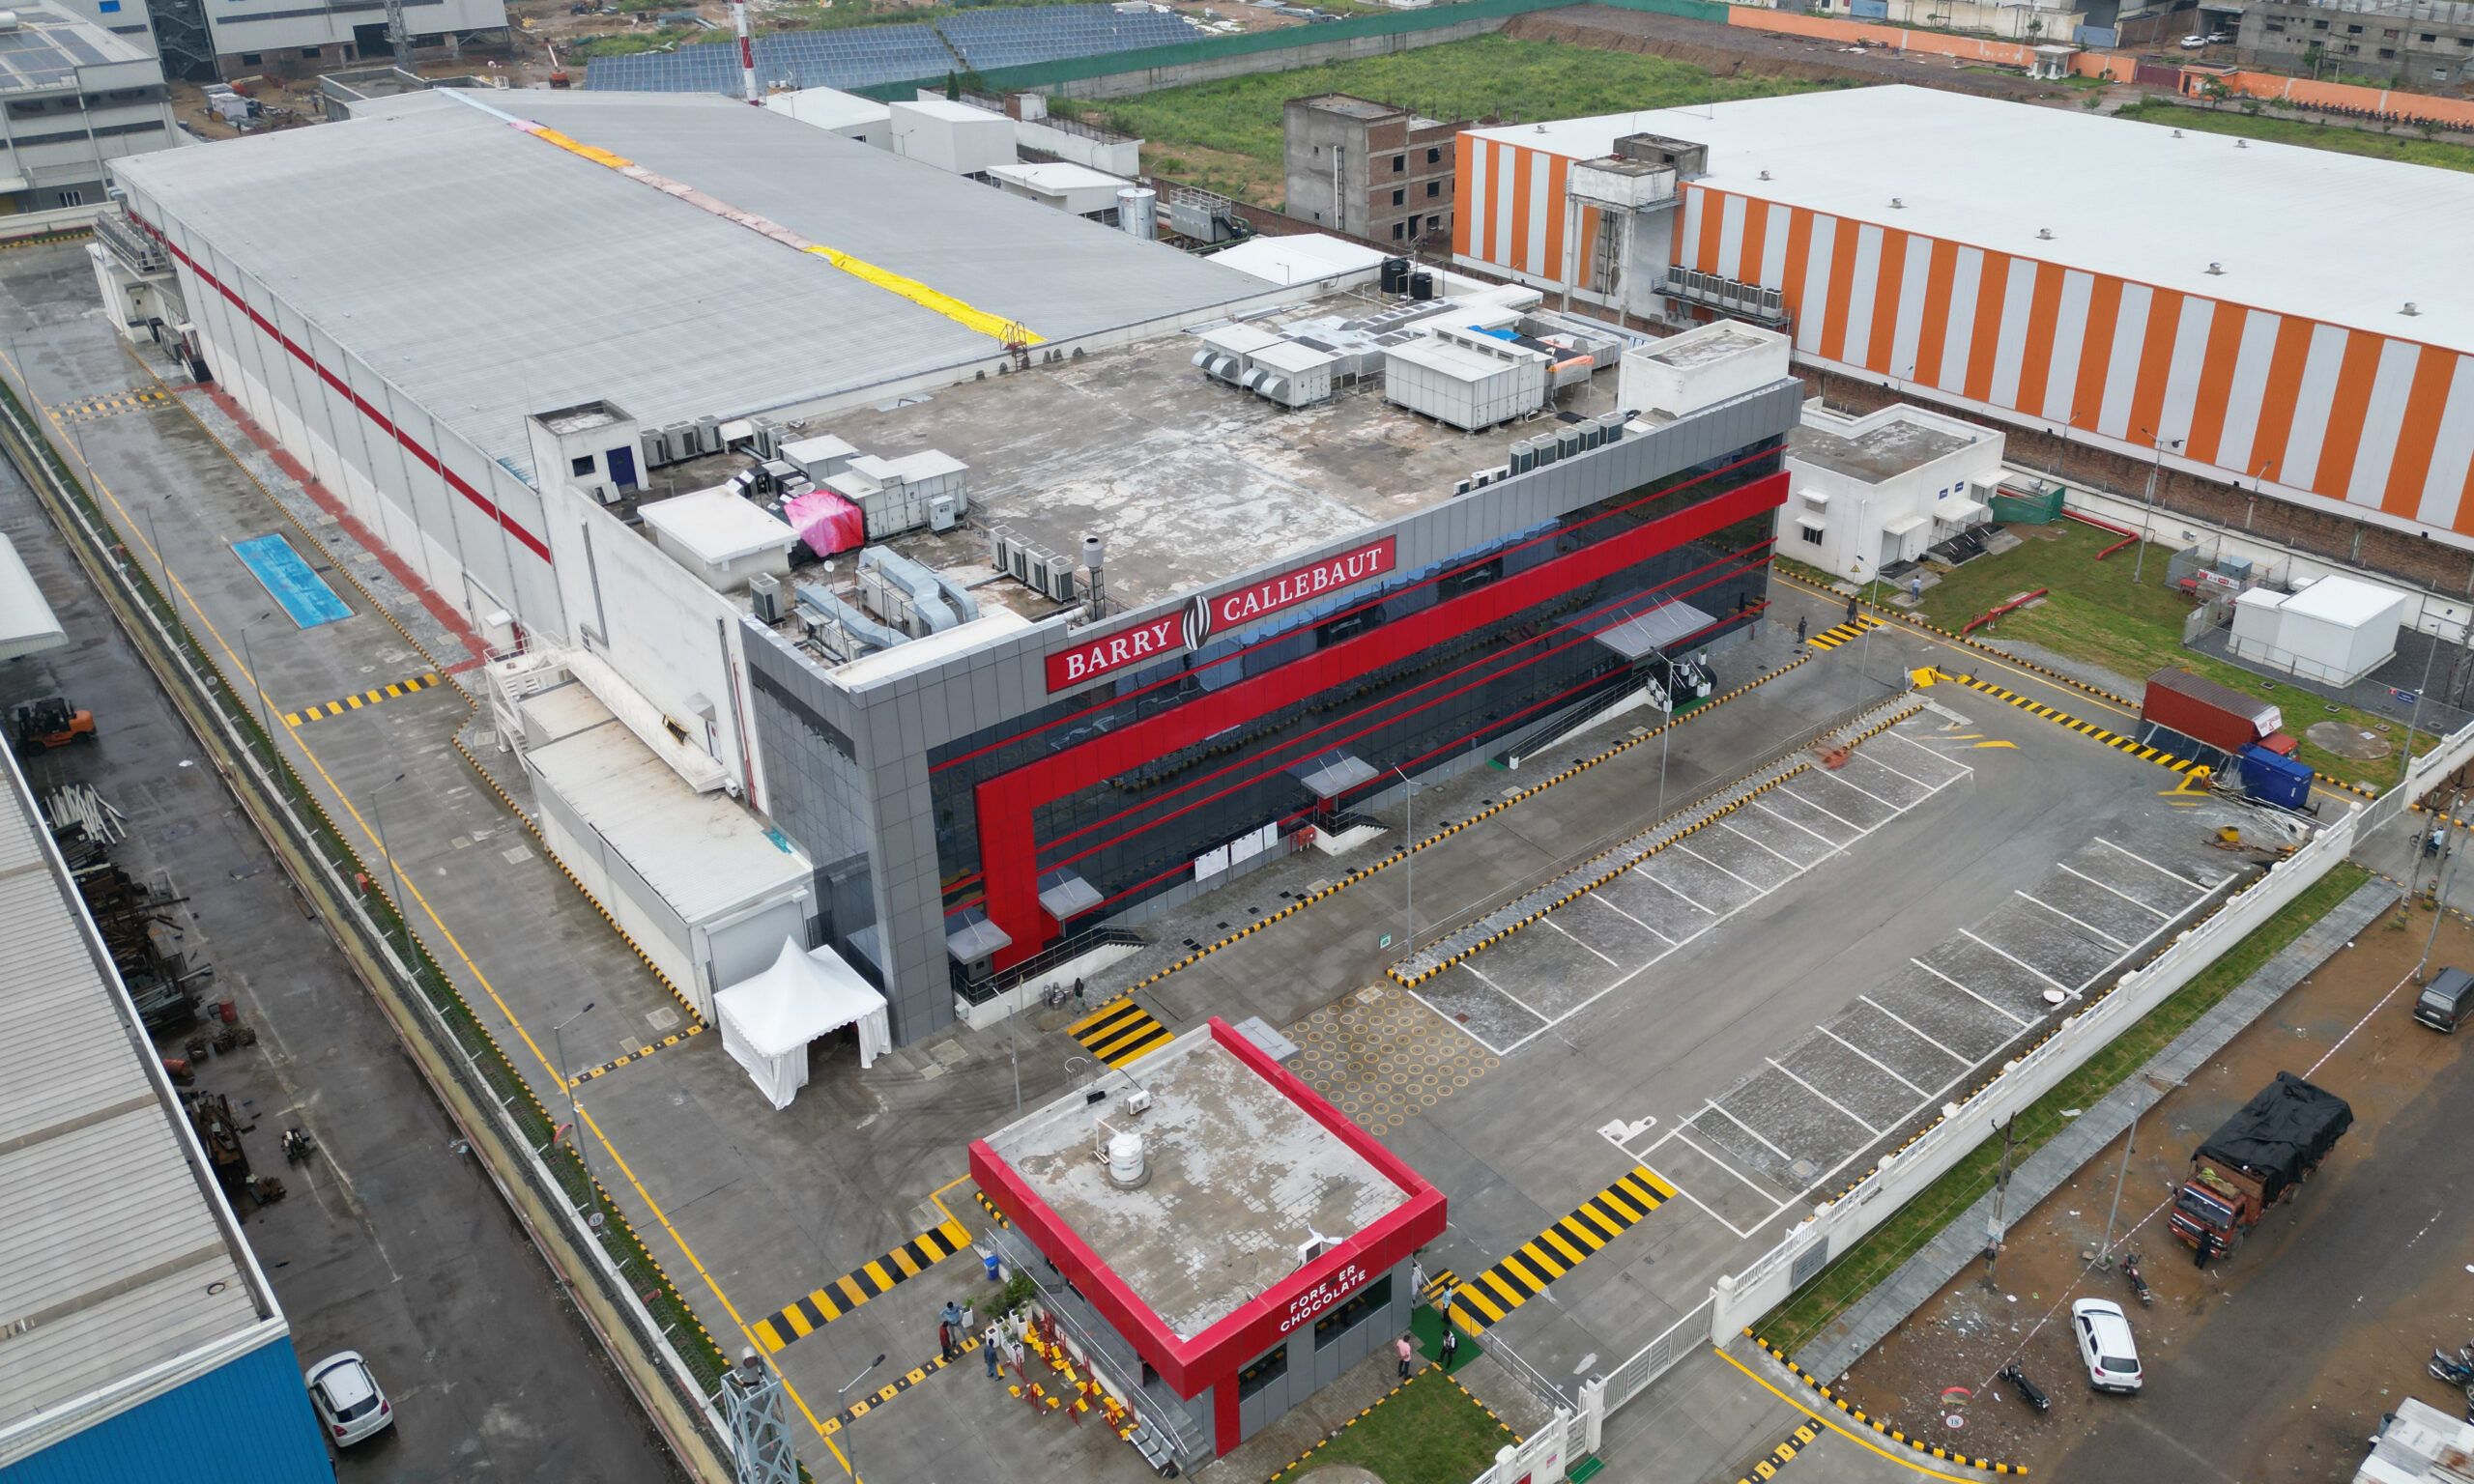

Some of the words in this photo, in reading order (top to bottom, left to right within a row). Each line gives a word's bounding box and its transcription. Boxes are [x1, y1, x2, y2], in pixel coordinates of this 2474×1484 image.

[1066, 620, 1171, 680] BARRY
[1223, 547, 1382, 621] CALLEBAUT
[1280, 1270, 1366, 1332] CHOCOLATE
